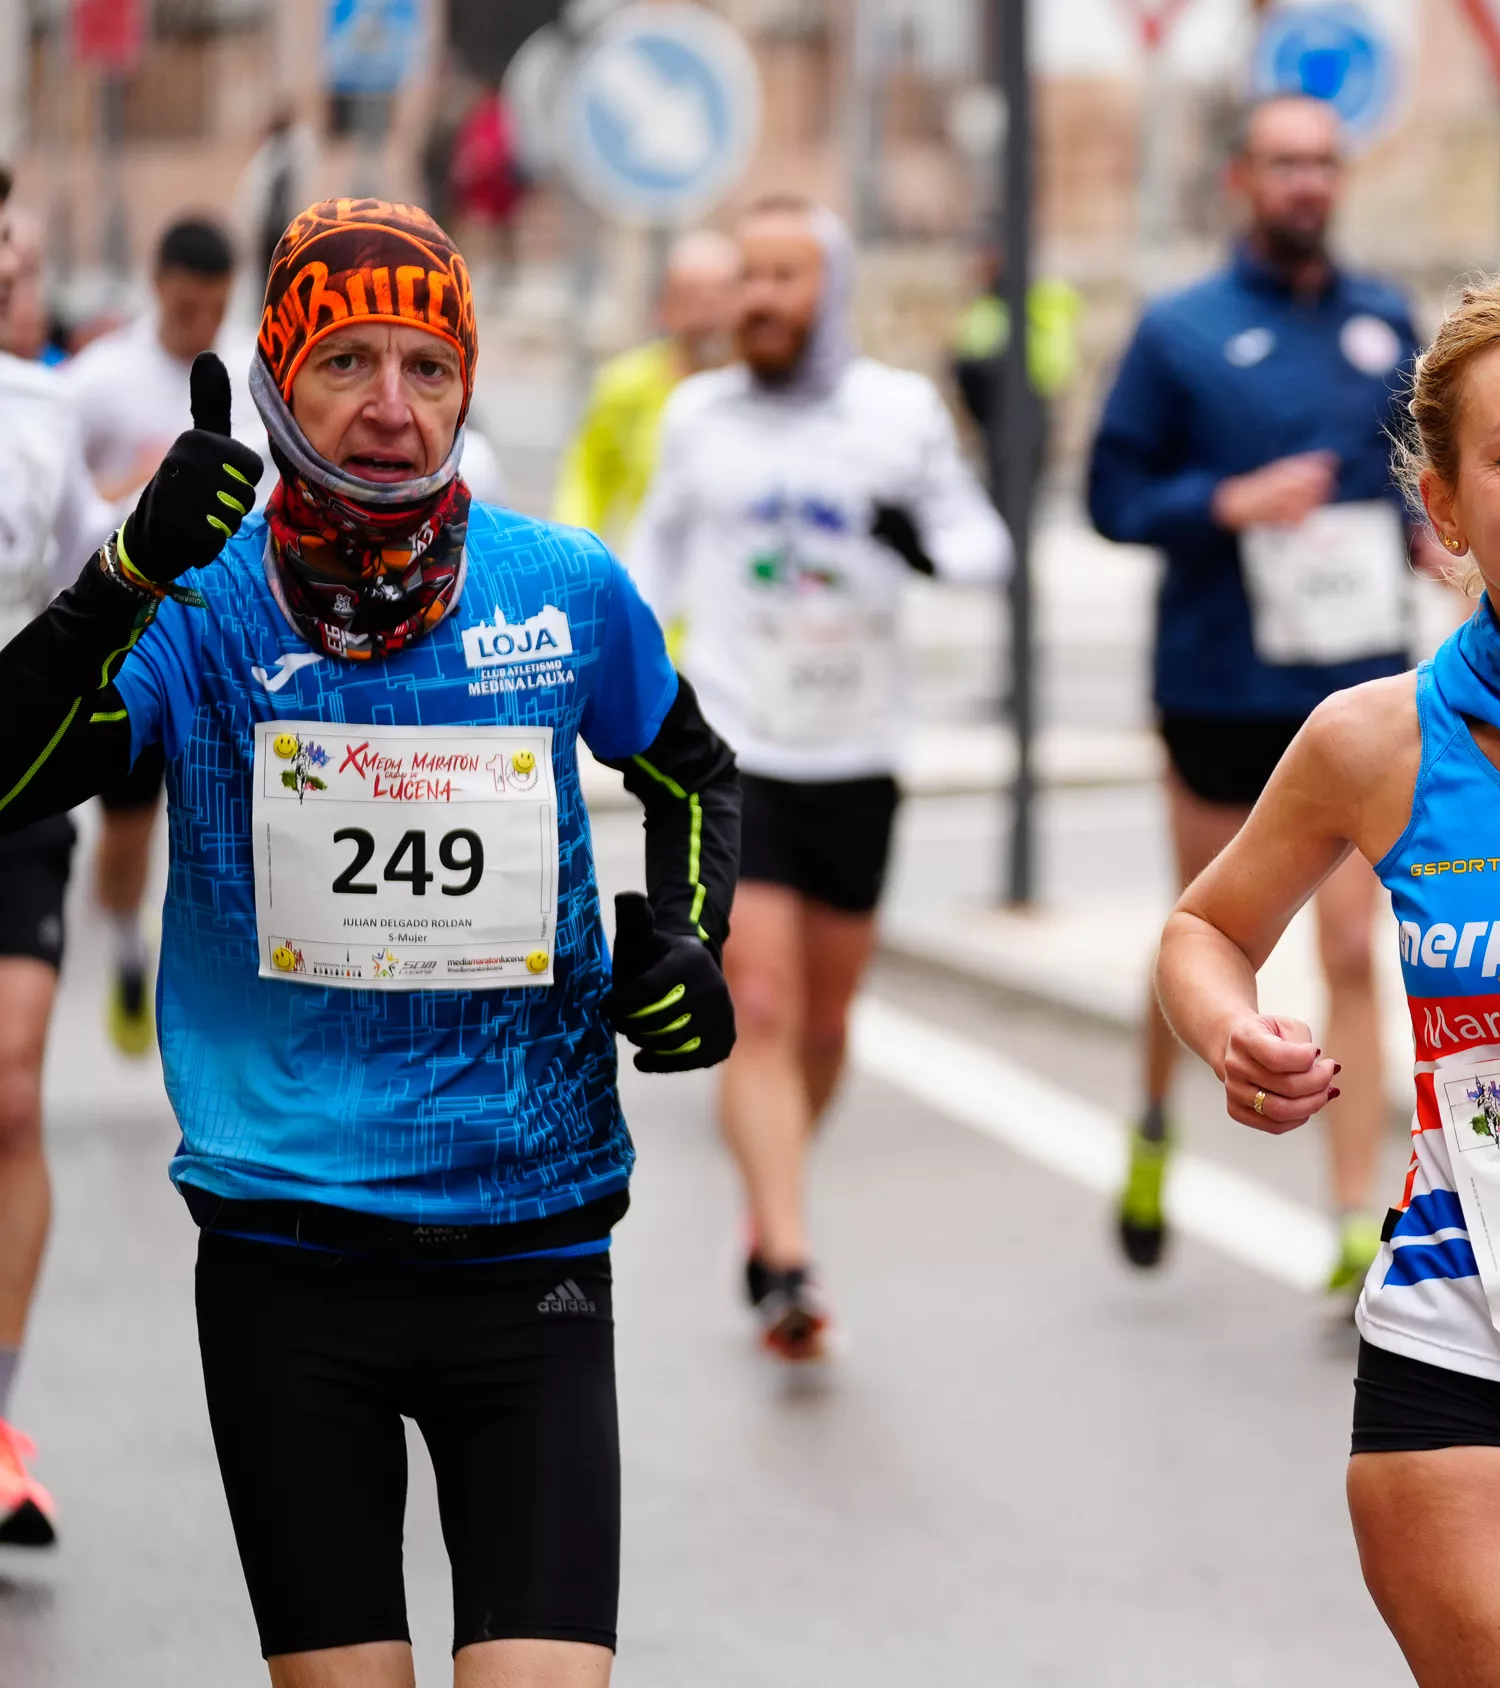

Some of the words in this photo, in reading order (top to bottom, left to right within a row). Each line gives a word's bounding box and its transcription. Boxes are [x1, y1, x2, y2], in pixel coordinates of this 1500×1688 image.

[477, 627, 558, 657] LOJA
[481, 668, 506, 680] CLUB
[507, 660, 563, 677] ATLETISMO
[468, 678, 526, 697] MEDINA
[527, 670, 575, 688] LAUXA
[412, 752, 479, 773] MARATÓN
[373, 773, 465, 803] LUCENA
[332, 826, 484, 896] 249
[342, 917, 377, 928] JULIAN
[380, 918, 428, 928] DELGADO
[431, 918, 472, 928] ROLDAN
[388, 932, 428, 944] S-Mujer
[537, 1299, 596, 1314] adidas
